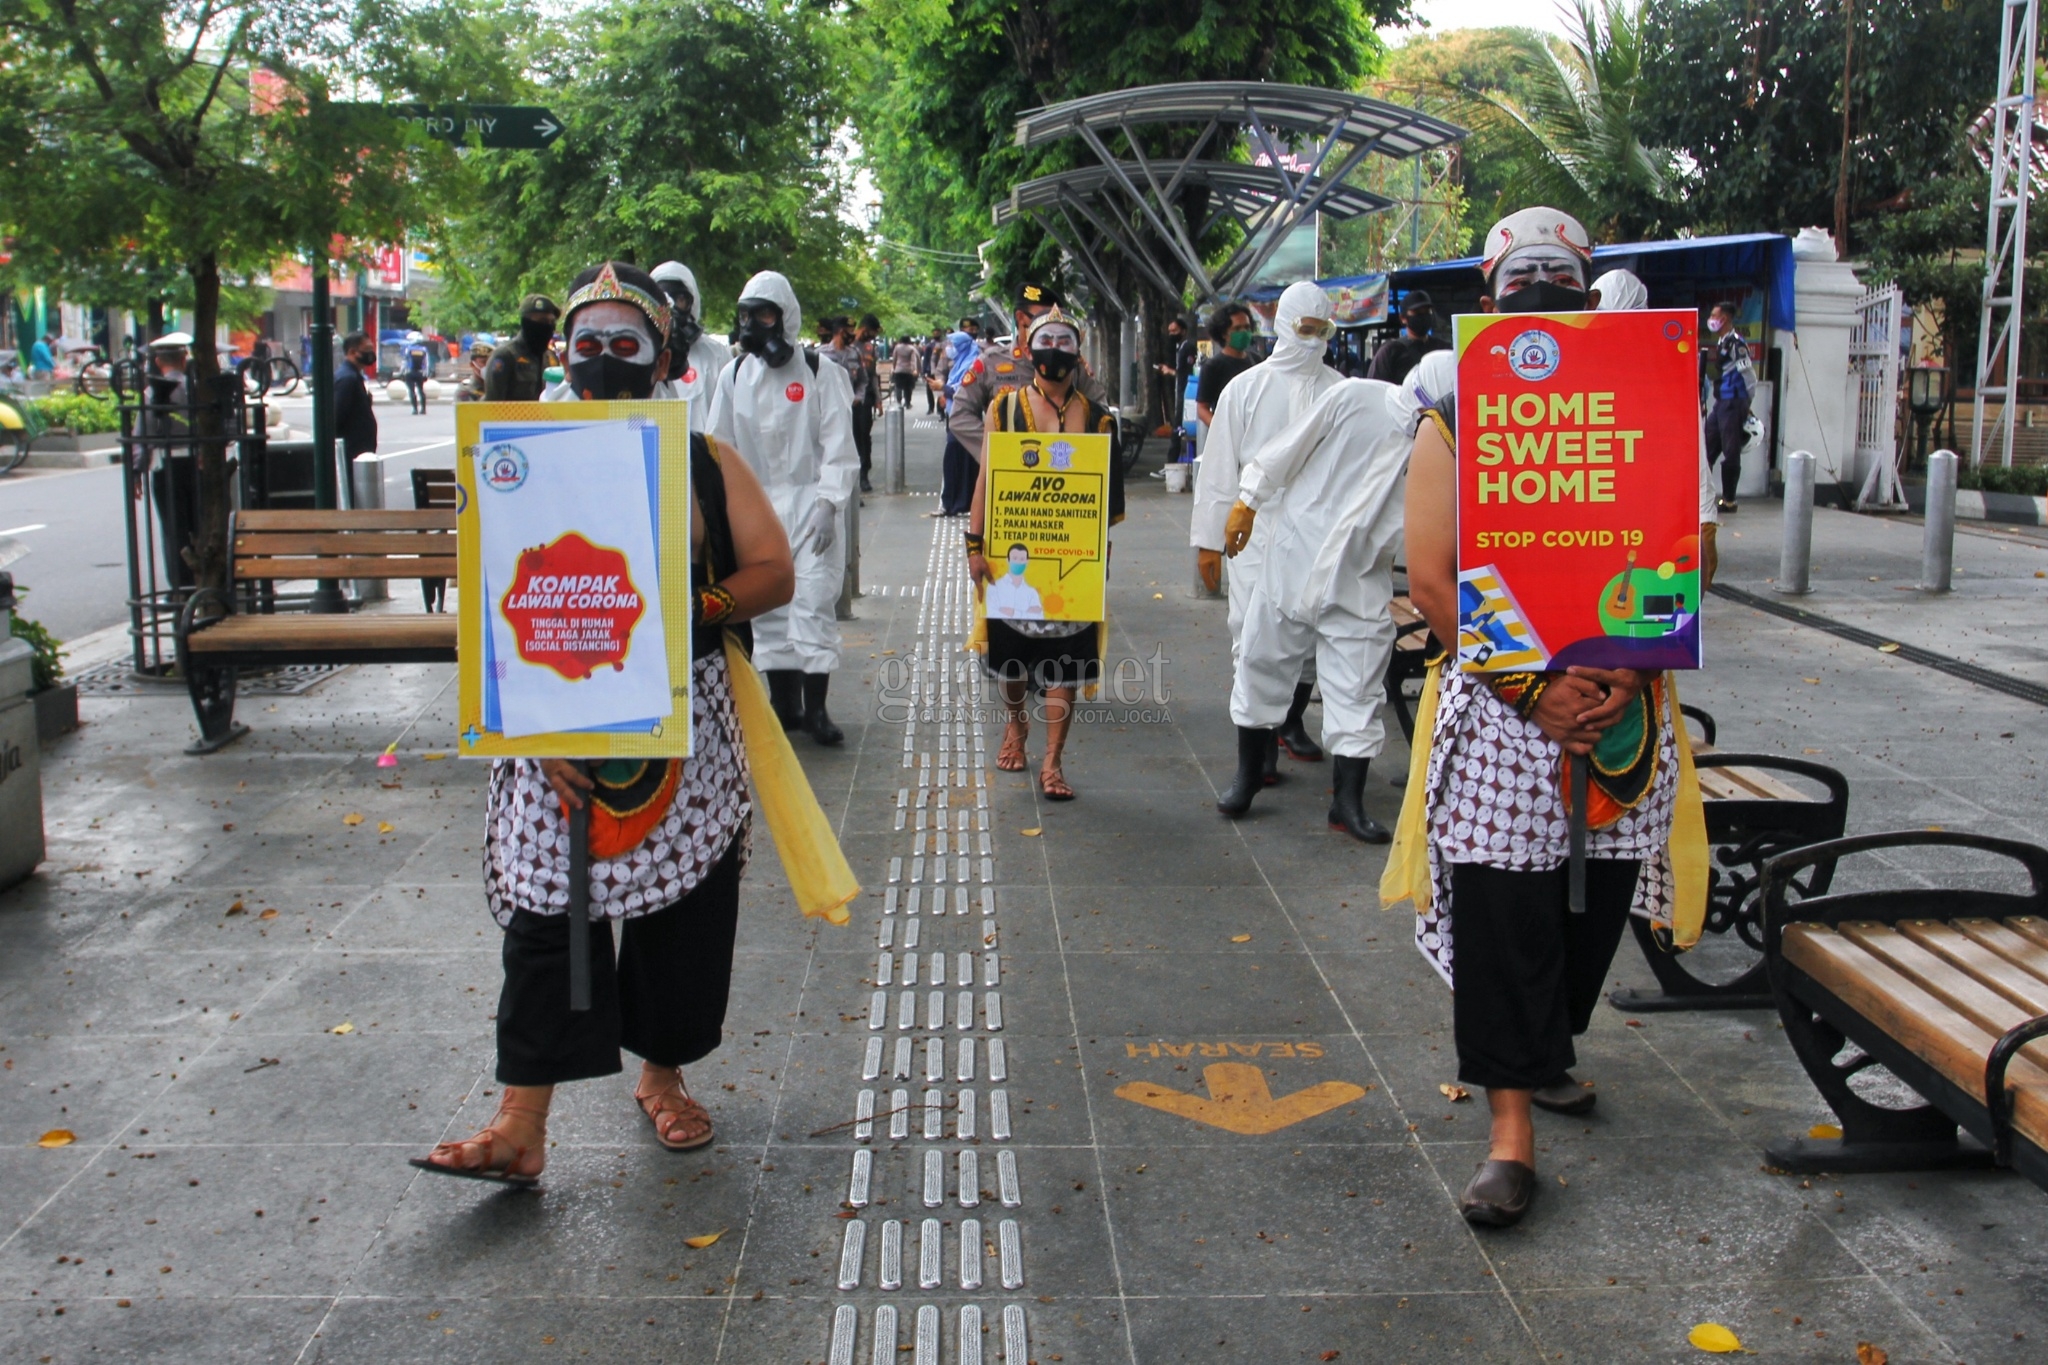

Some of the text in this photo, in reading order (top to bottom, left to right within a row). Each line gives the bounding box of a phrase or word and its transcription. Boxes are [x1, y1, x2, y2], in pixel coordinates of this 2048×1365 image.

[1477, 392, 1615, 427] HOME
[1476, 430, 1644, 466] SWEET
[1030, 476, 1065, 491] AYO
[1478, 470, 1616, 504] HOME
[998, 491, 1096, 504] LAWAN CORONA
[995, 507, 1098, 519] 1. PAKAI HAND SANITIZER
[994, 519, 1064, 530] 2. PAKAI MASKER
[993, 531, 1070, 542] 3. TETAP DI RUMAH
[1476, 529, 1644, 548] STOP COVID 19
[1034, 547, 1094, 556] STOP COVID-19
[527, 575, 620, 593] KOMPAK
[507, 594, 638, 609] LAWAN CORONA
[531, 618, 614, 629] TINGGAL DI RUMAH
[534, 629, 610, 639] DAN JAGA JARAK
[525, 640, 620, 652] (SOCIAL DISTANCING)
[1125, 1042, 1325, 1058] SEARAH
